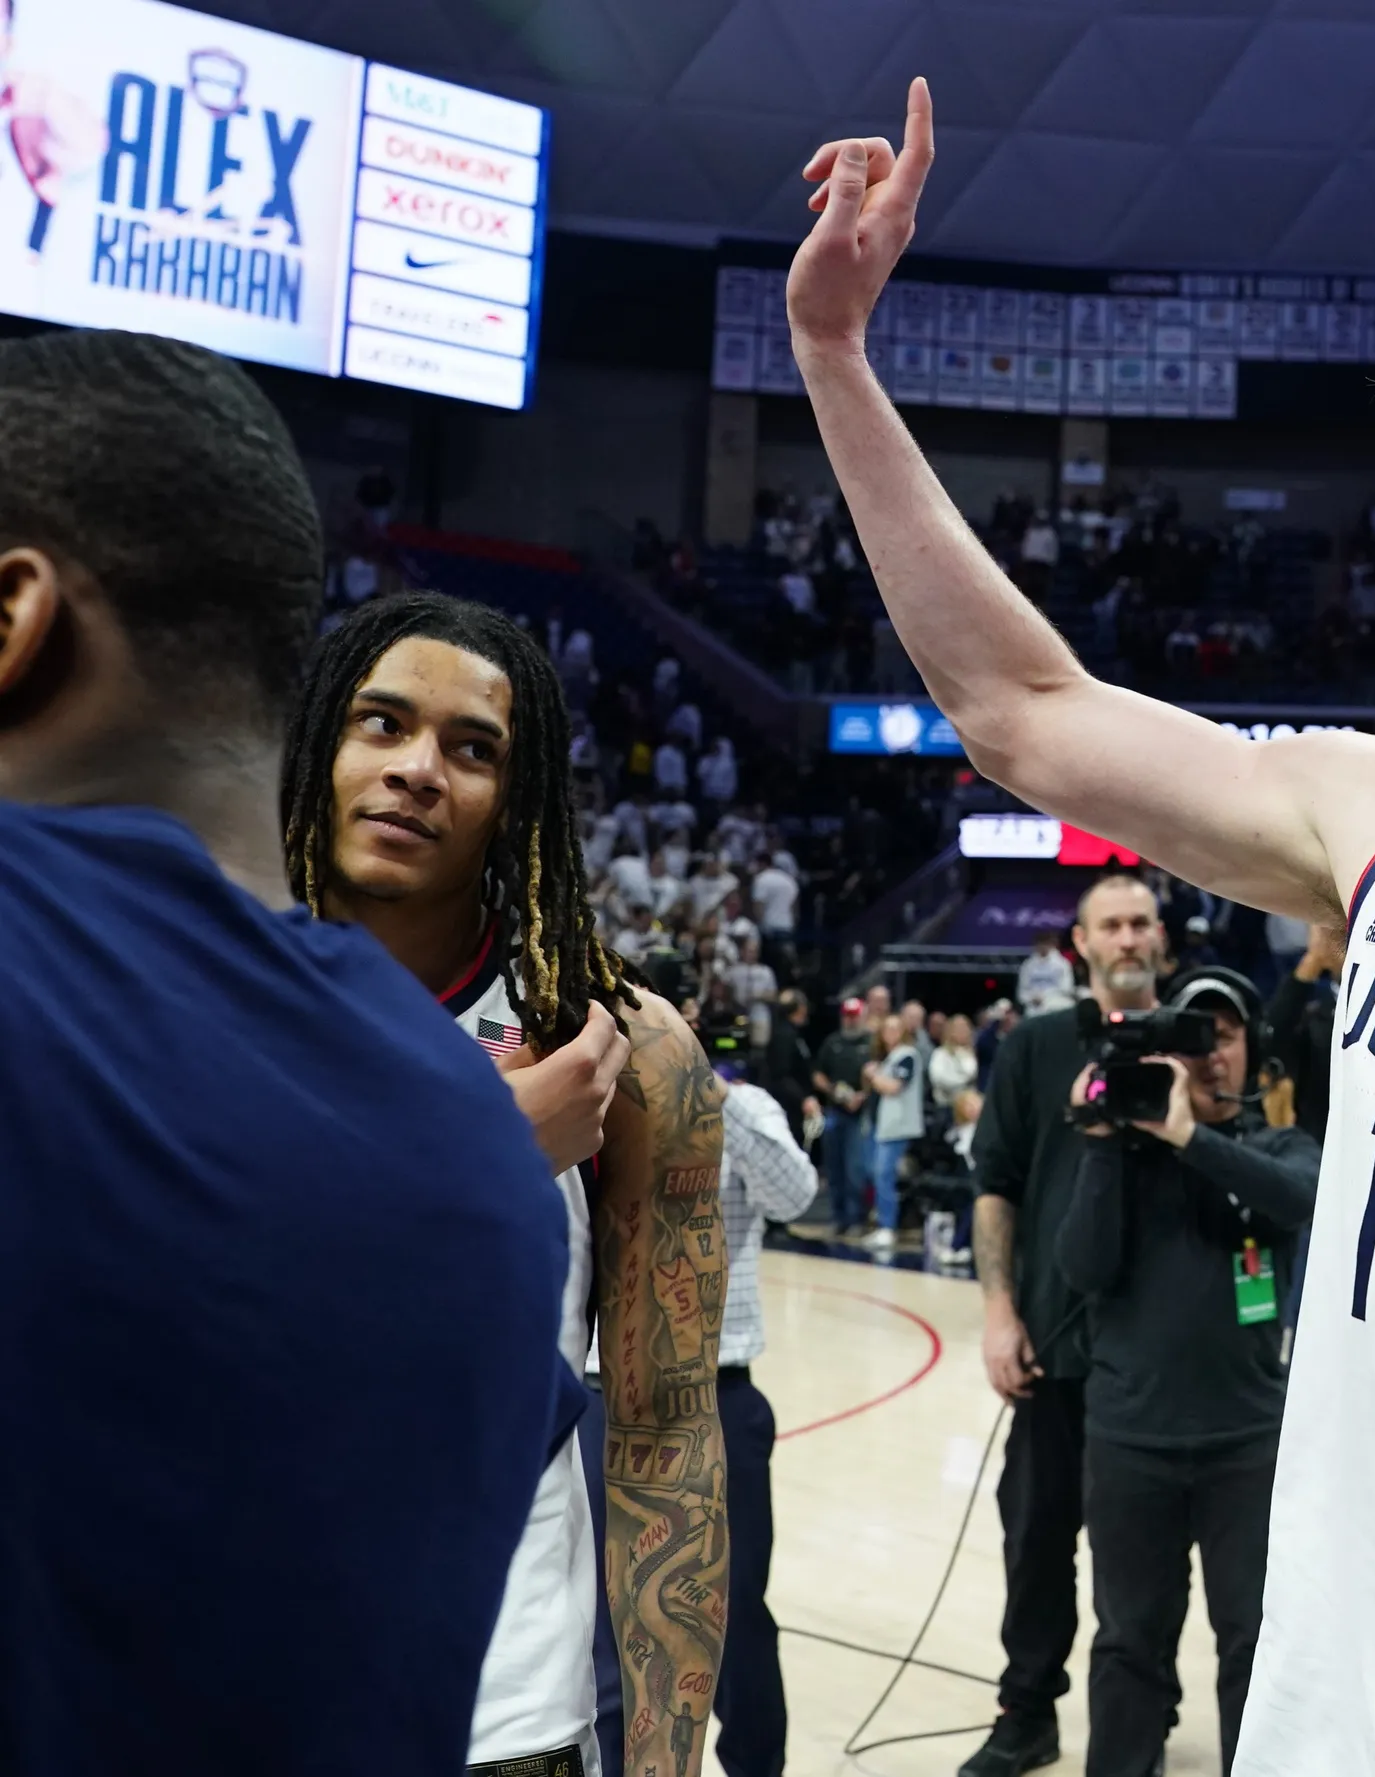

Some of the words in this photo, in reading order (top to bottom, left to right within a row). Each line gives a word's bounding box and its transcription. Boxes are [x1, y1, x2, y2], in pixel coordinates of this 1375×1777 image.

[100, 71, 312, 246] ALEX
[383, 184, 509, 238] xerox
[674, 1287, 691, 1313] 5
[639, 1517, 669, 1555] MAN
[678, 1671, 713, 1695] GOD
[501, 1760, 544, 1773] ENGINEERED
